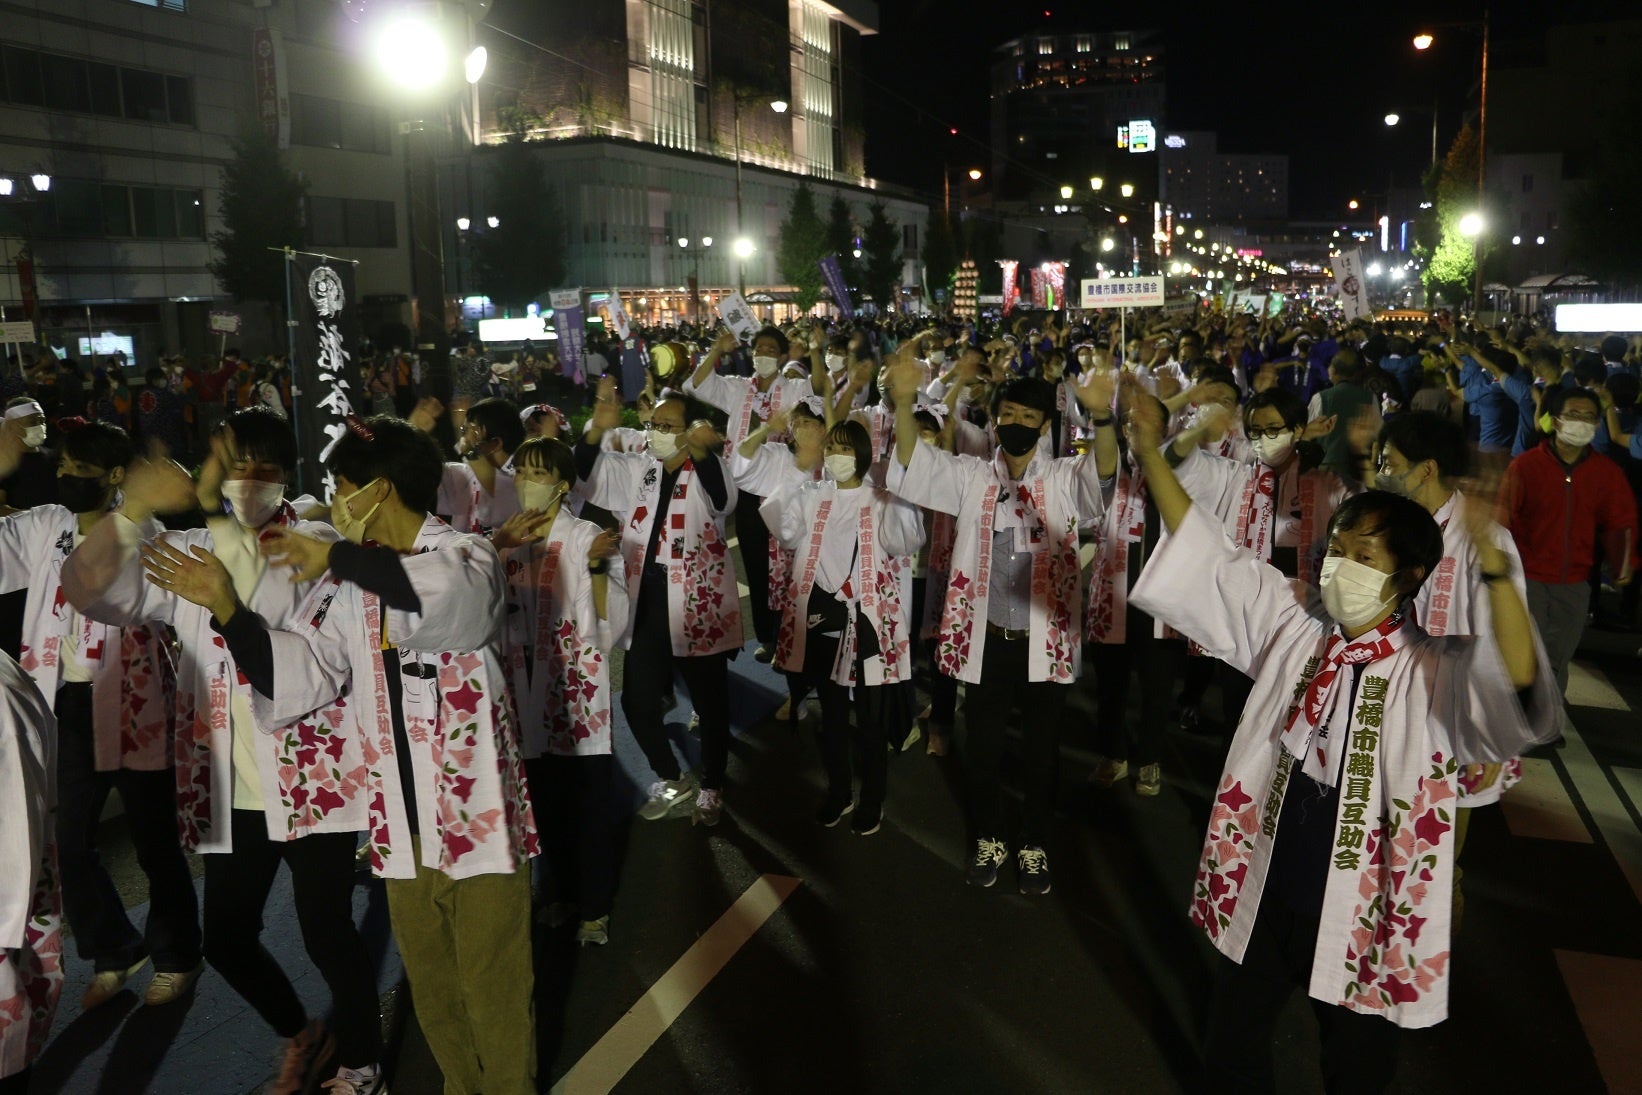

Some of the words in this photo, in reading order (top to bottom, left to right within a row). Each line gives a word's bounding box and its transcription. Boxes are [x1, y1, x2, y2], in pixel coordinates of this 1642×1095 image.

[1333, 674, 1391, 872] 豊橋市職員互助会
